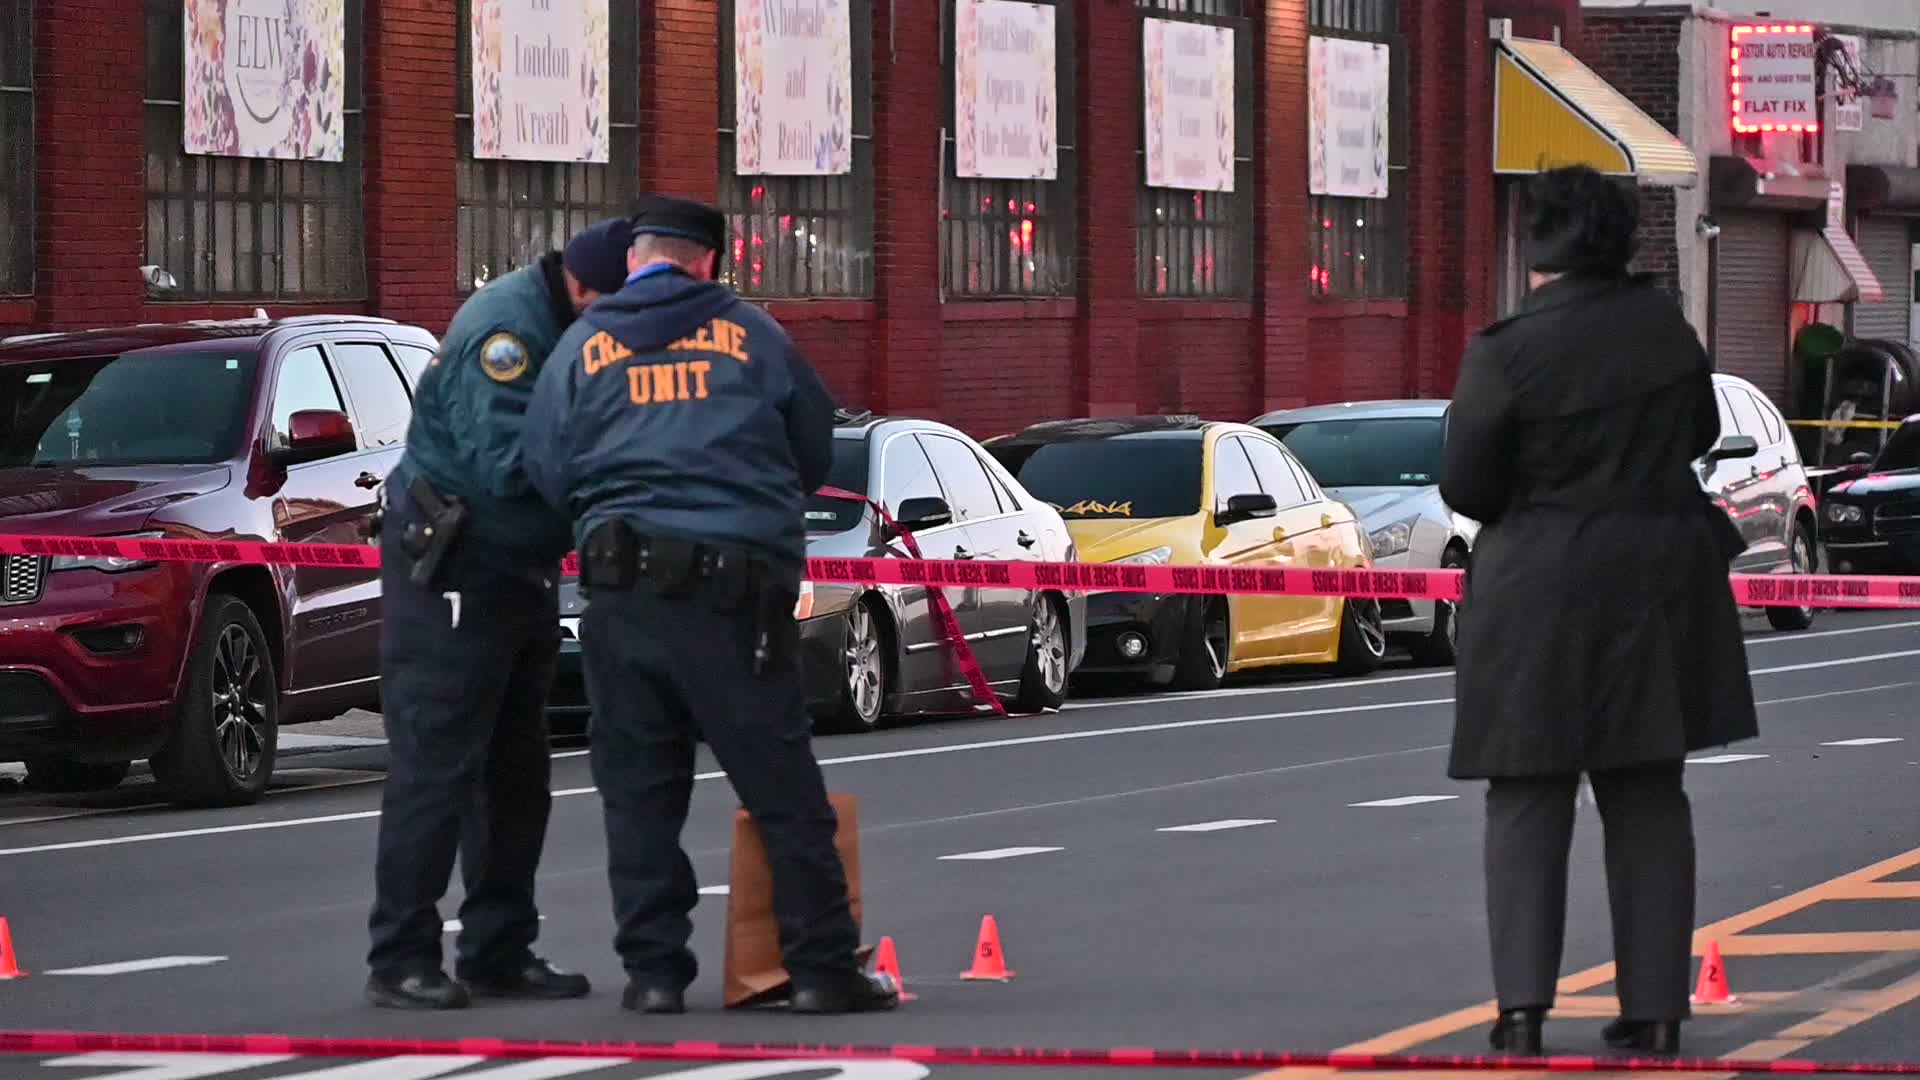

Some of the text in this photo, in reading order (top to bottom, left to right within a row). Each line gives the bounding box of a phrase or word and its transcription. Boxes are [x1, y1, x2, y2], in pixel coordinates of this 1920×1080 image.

[236, 14, 282, 69] ELW
[514, 33, 569, 79] London
[784, 56, 806, 99] and
[515, 101, 568, 145] Wreath
[1744, 100, 1807, 113] FLAT FIX
[667, 318, 749, 362] ENE
[626, 360, 712, 405] UNIT
[981, 942, 992, 957] 5
[1709, 965, 1719, 982] 2
